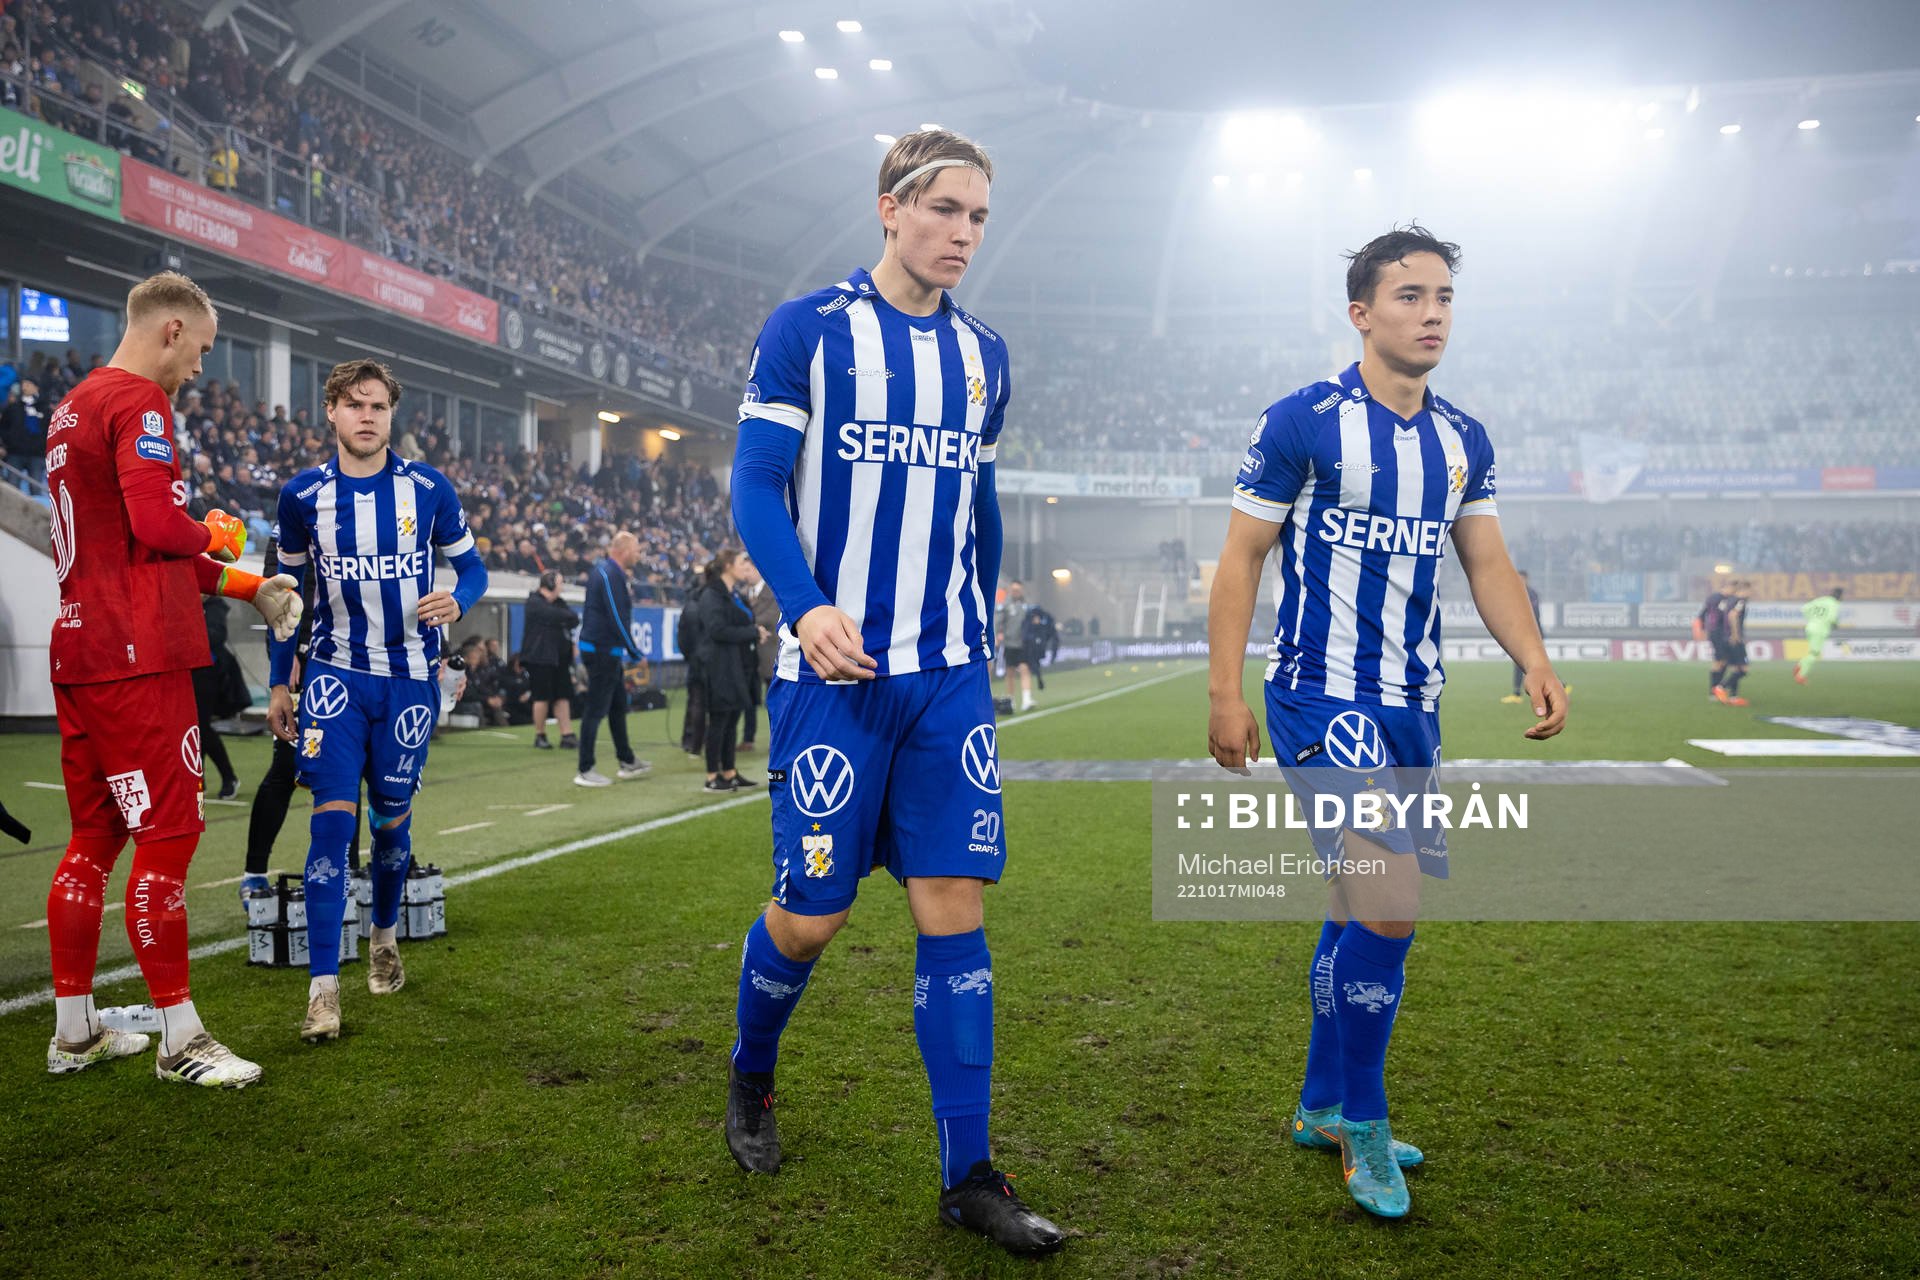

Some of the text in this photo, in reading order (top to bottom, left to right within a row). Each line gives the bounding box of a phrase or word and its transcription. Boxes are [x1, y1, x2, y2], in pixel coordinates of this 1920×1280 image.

[140, 441, 171, 454] UNIBET
[409, 470, 435, 489] FAMECO
[296, 480, 323, 500] FAMECO
[1318, 508, 1453, 556] SERNEK
[319, 554, 424, 581] SERNEKE
[1622, 639, 1774, 661] BEVEO
[397, 754, 415, 774] 14
[384, 775, 408, 784] CRAFT
[115, 790, 144, 810] KT
[972, 808, 1000, 844] 20
[968, 843, 994, 854] CRAFT
[1420, 847, 1448, 858] CRAF
